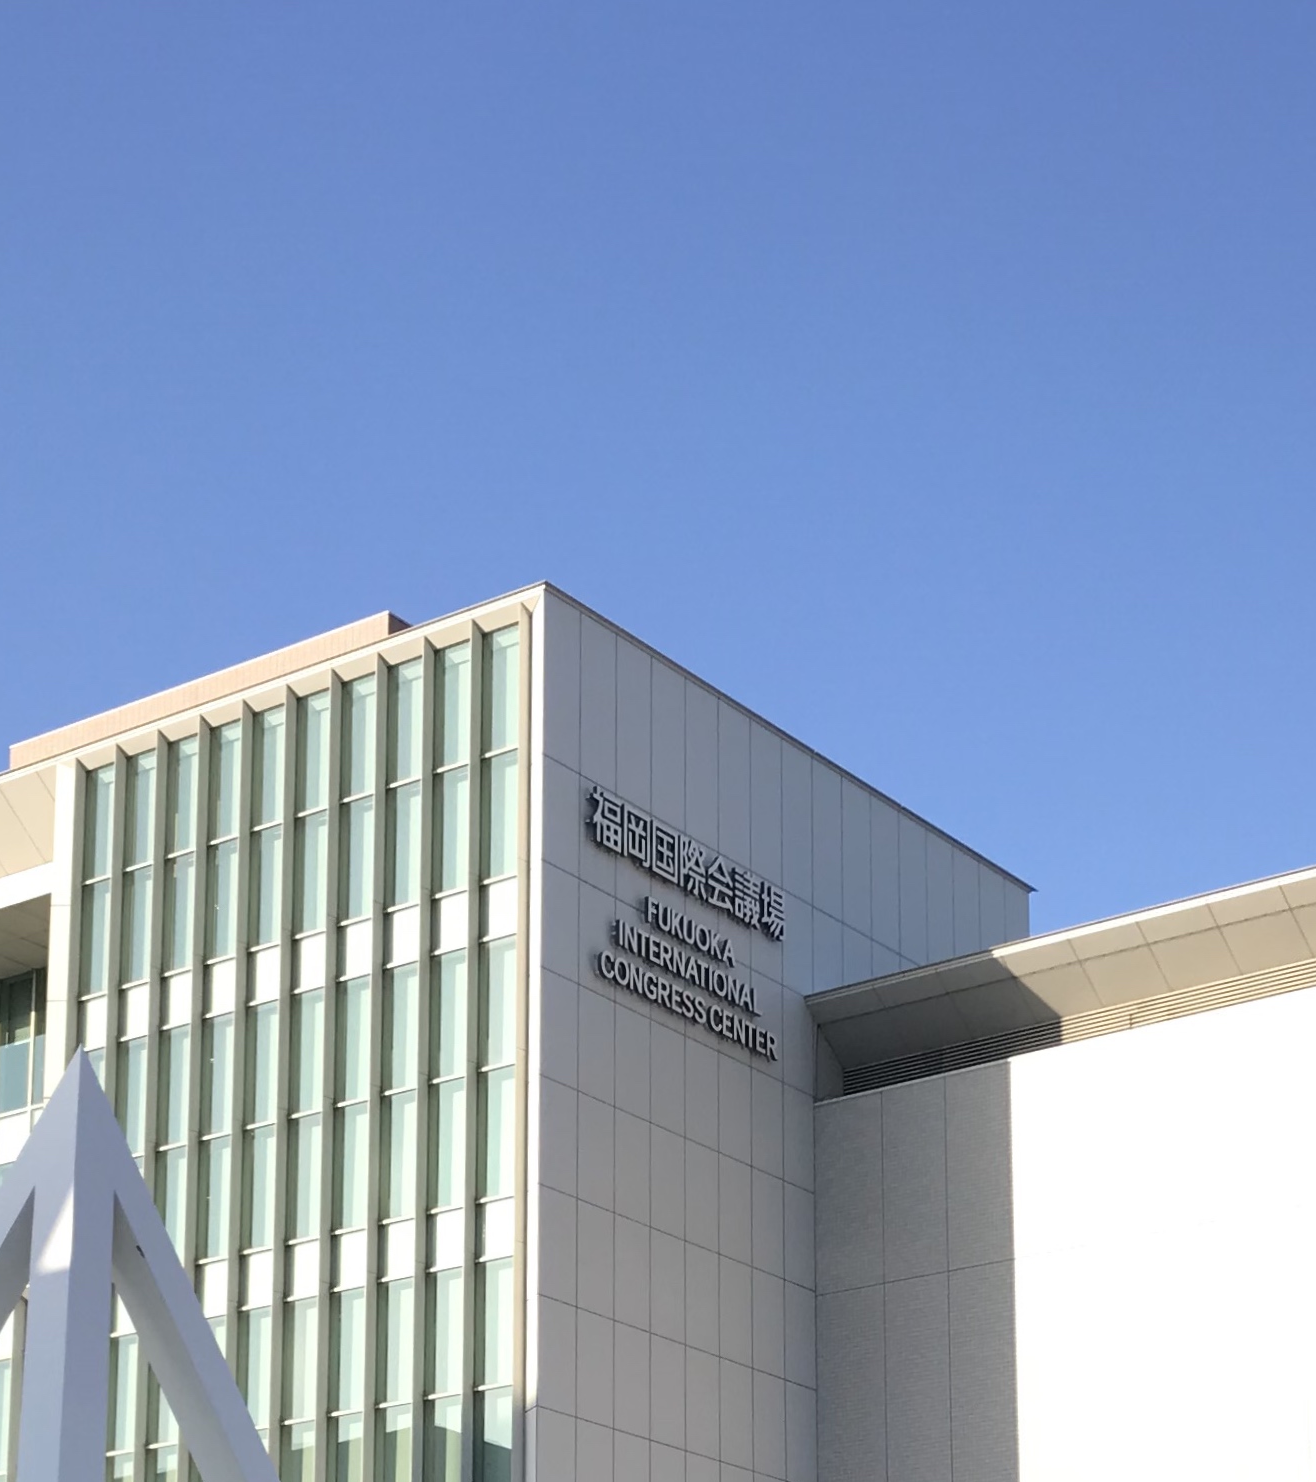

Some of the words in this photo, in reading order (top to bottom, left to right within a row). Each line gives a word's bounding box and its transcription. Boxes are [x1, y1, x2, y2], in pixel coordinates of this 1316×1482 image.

[590, 787, 786, 941] 福岡国際会議場
[616, 919, 762, 1016] INTERNATIONAL
[646, 896, 735, 968] FUKUOKA
[600, 950, 706, 1025] CONGRESS
[708, 1005, 777, 1061] CENTER
